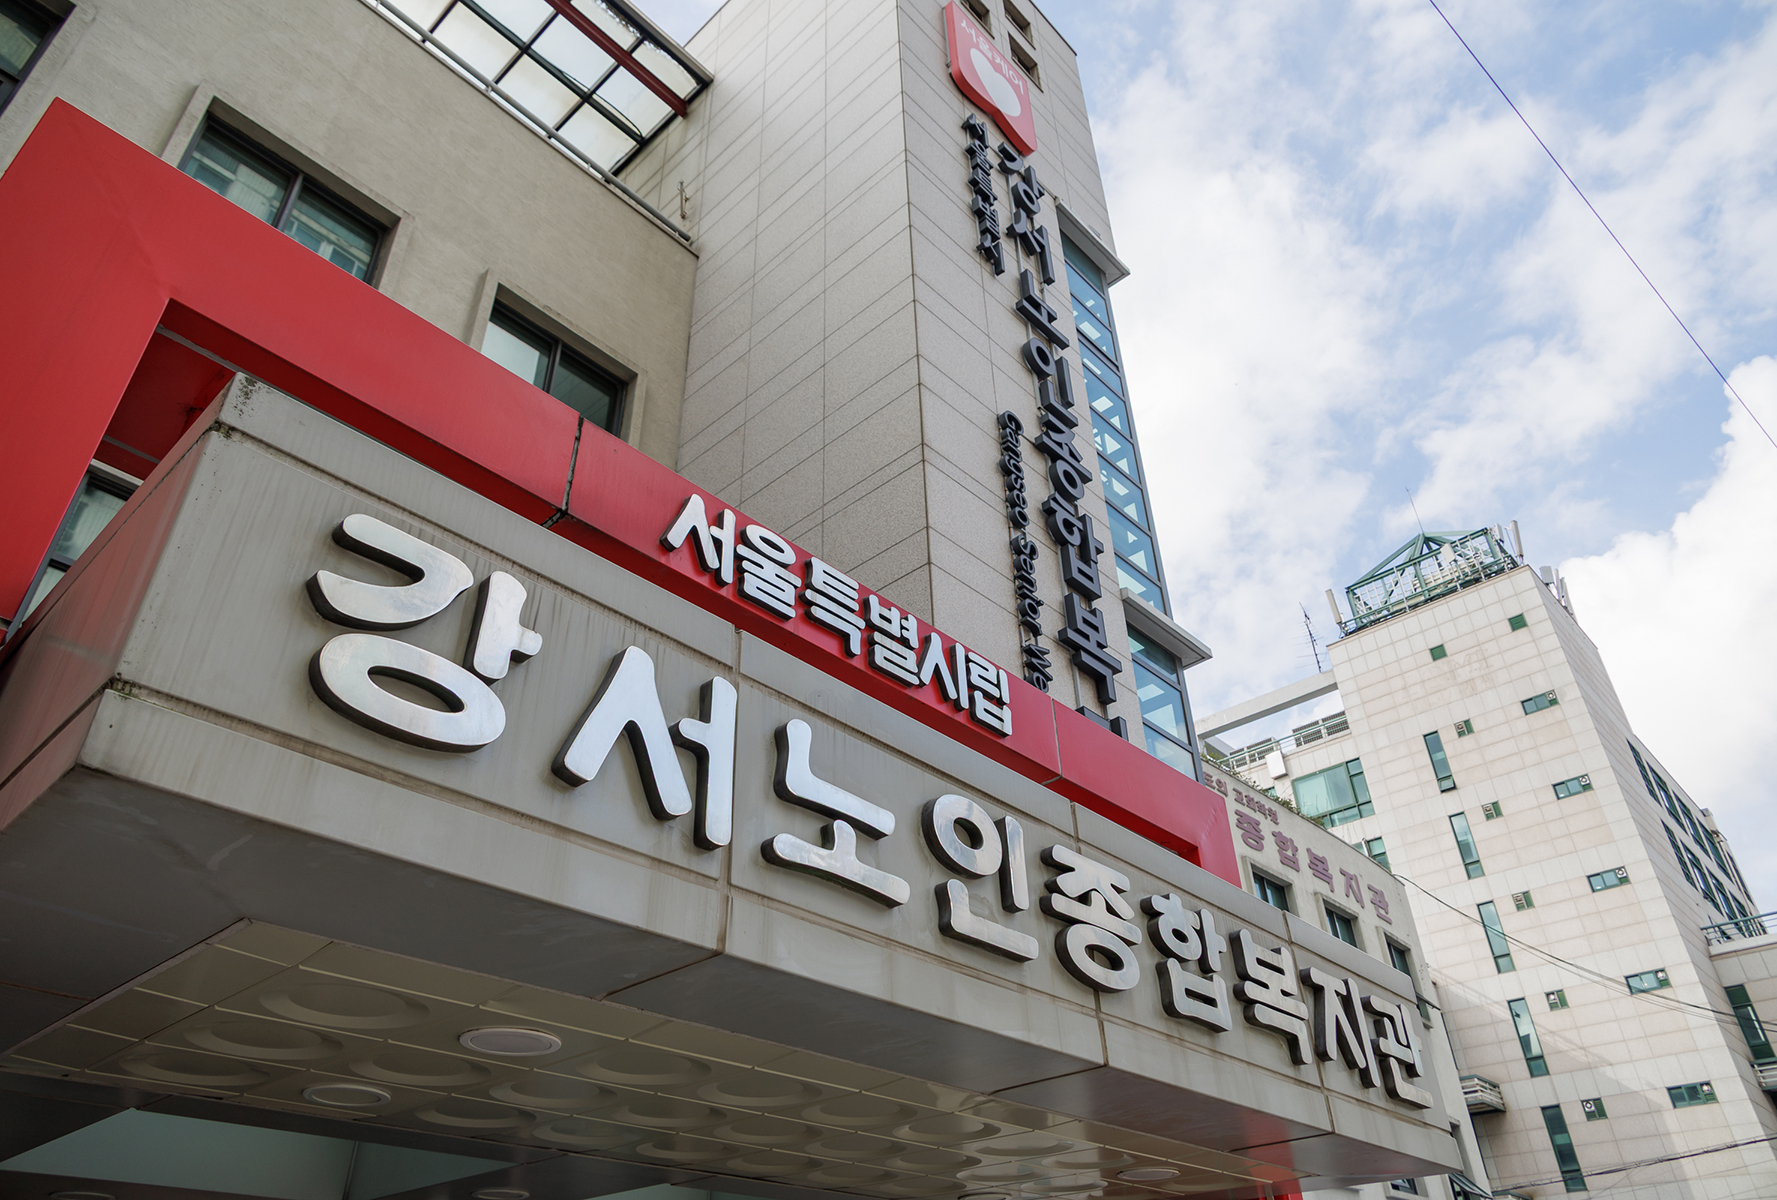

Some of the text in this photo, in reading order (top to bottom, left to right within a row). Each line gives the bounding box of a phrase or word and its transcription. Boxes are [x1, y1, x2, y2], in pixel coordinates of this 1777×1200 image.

[961, 19, 1024, 95] 서울케어
[996, 410, 1030, 529] Gangseo
[659, 493, 1013, 738] 서울특별시립
[1010, 533, 1045, 637] Senior
[305, 513, 1434, 1109] 강서노인종합복지관
